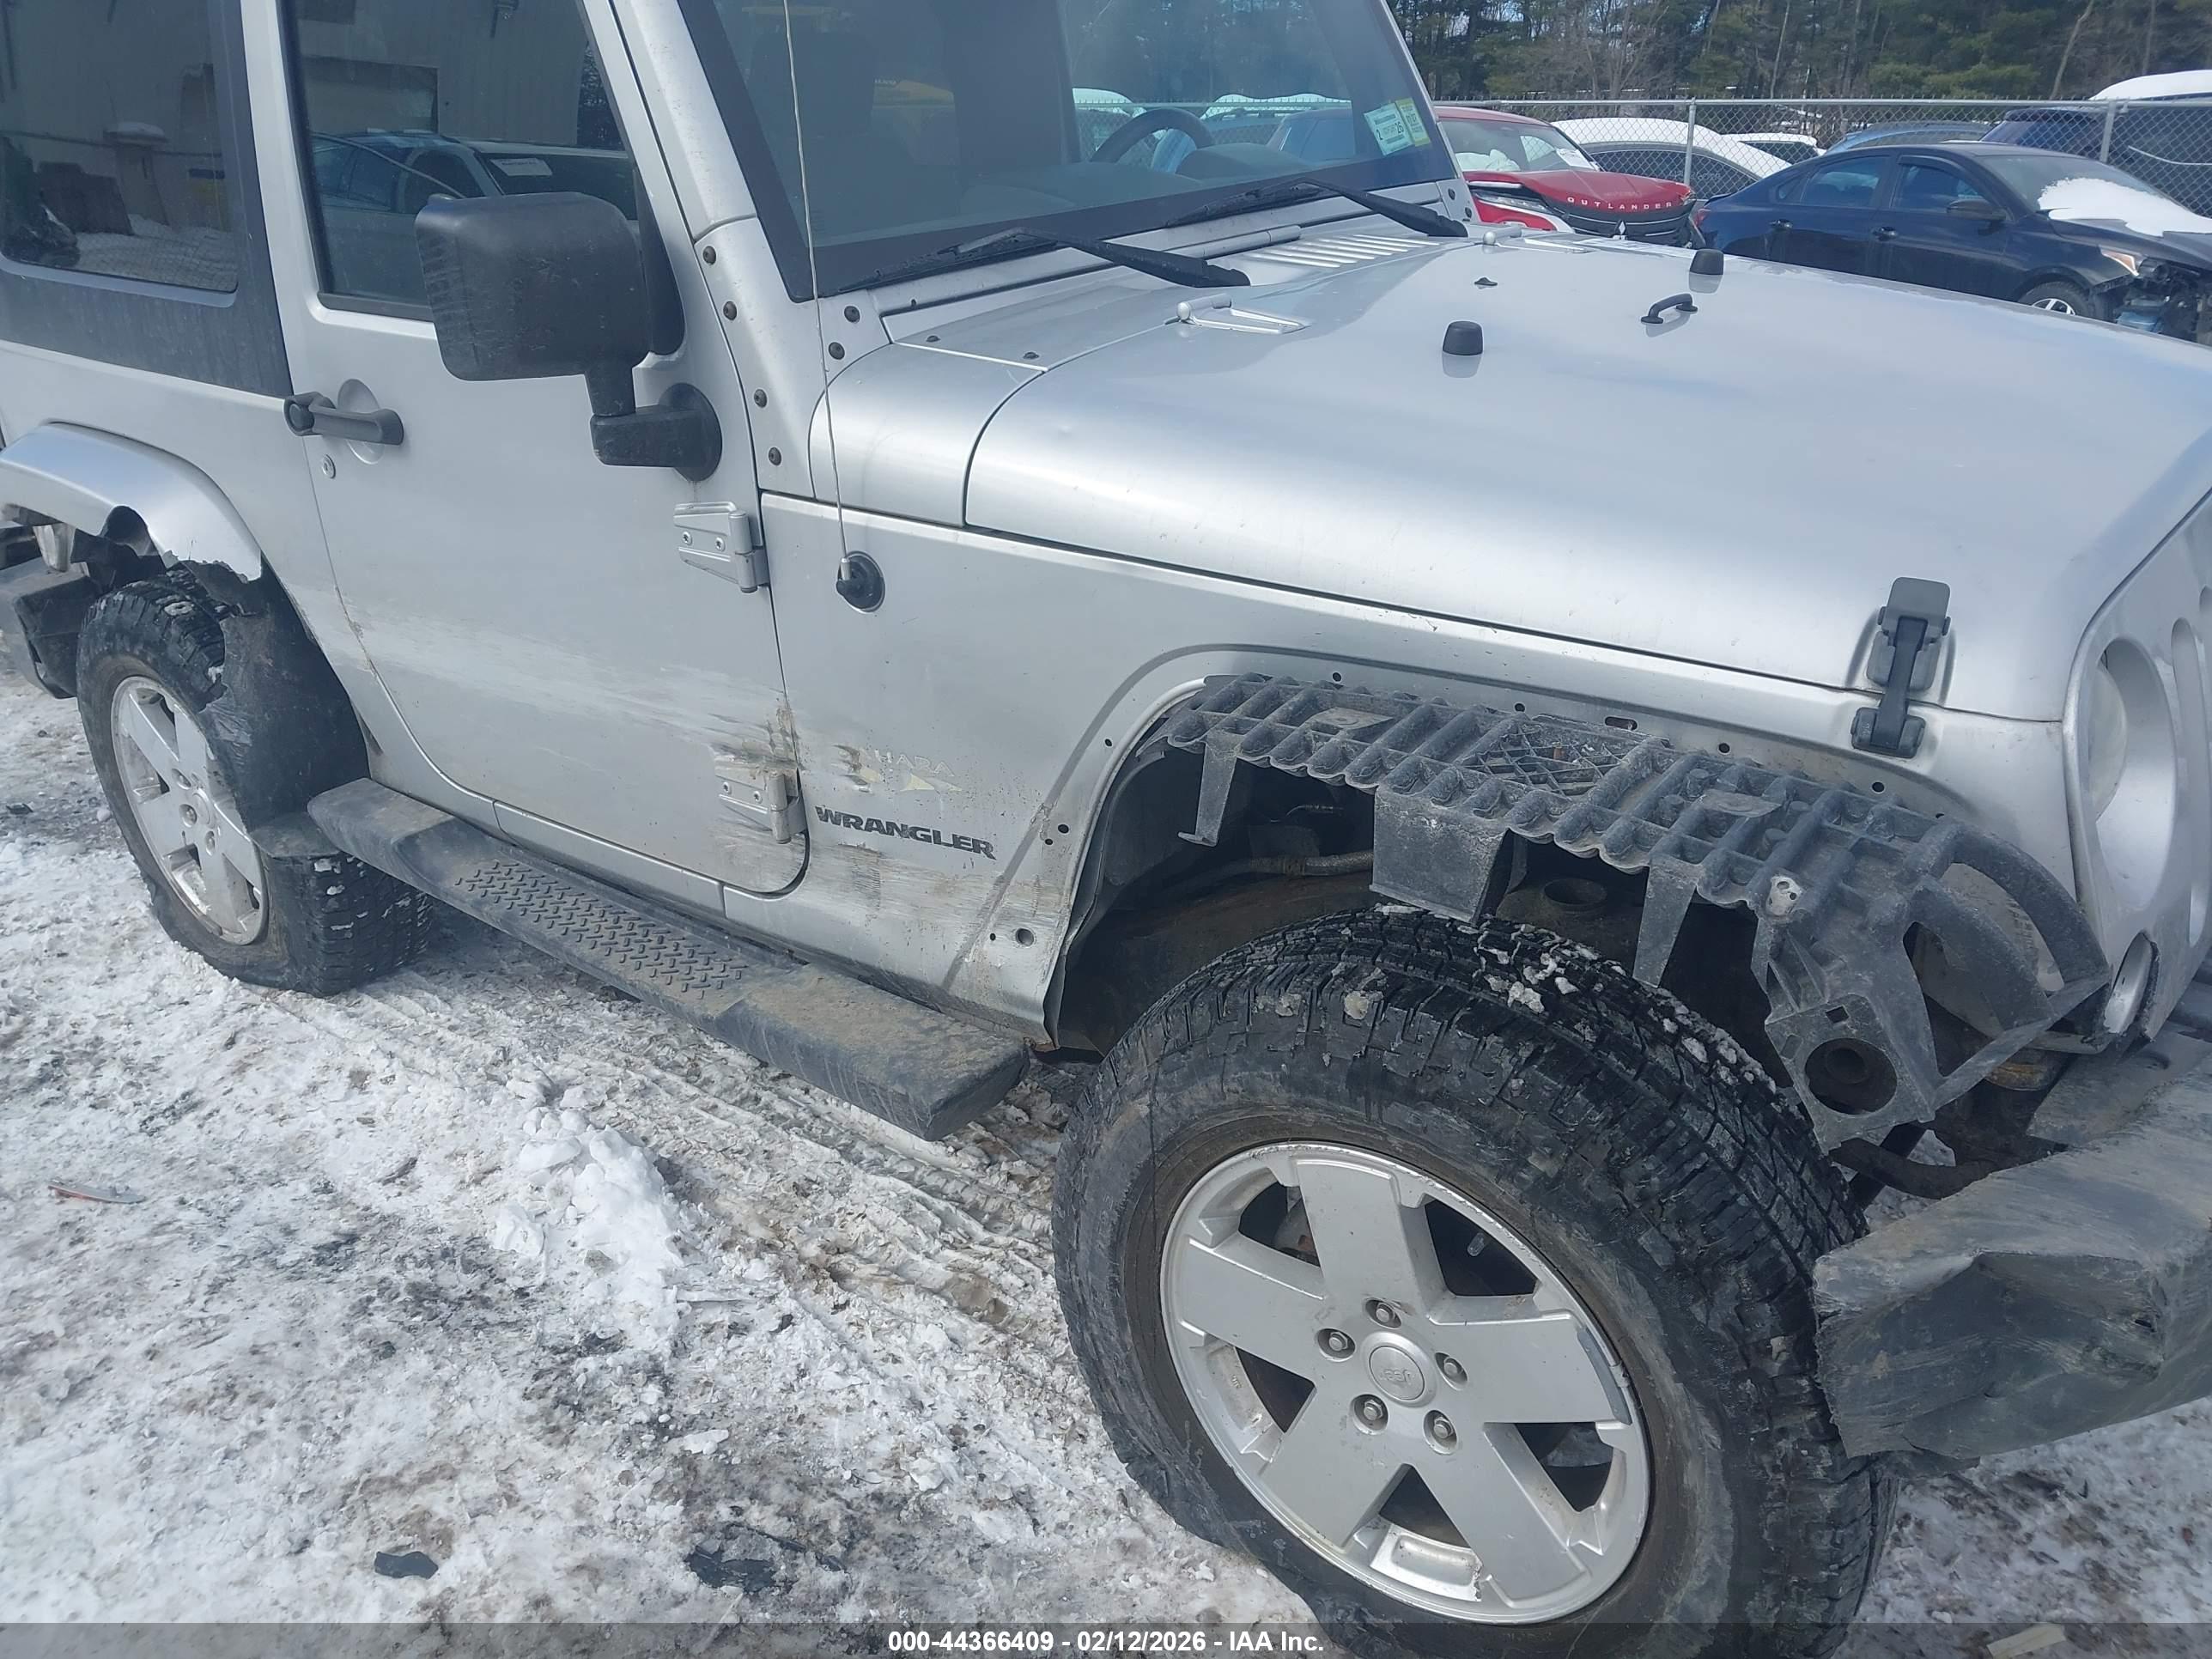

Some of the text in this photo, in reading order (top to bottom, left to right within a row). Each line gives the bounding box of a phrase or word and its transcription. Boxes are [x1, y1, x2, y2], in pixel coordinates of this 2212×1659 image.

[1566, 197, 1673, 210] OUTLANDER
[846, 746, 956, 778] HARA
[814, 805, 997, 860] WRANGLER
